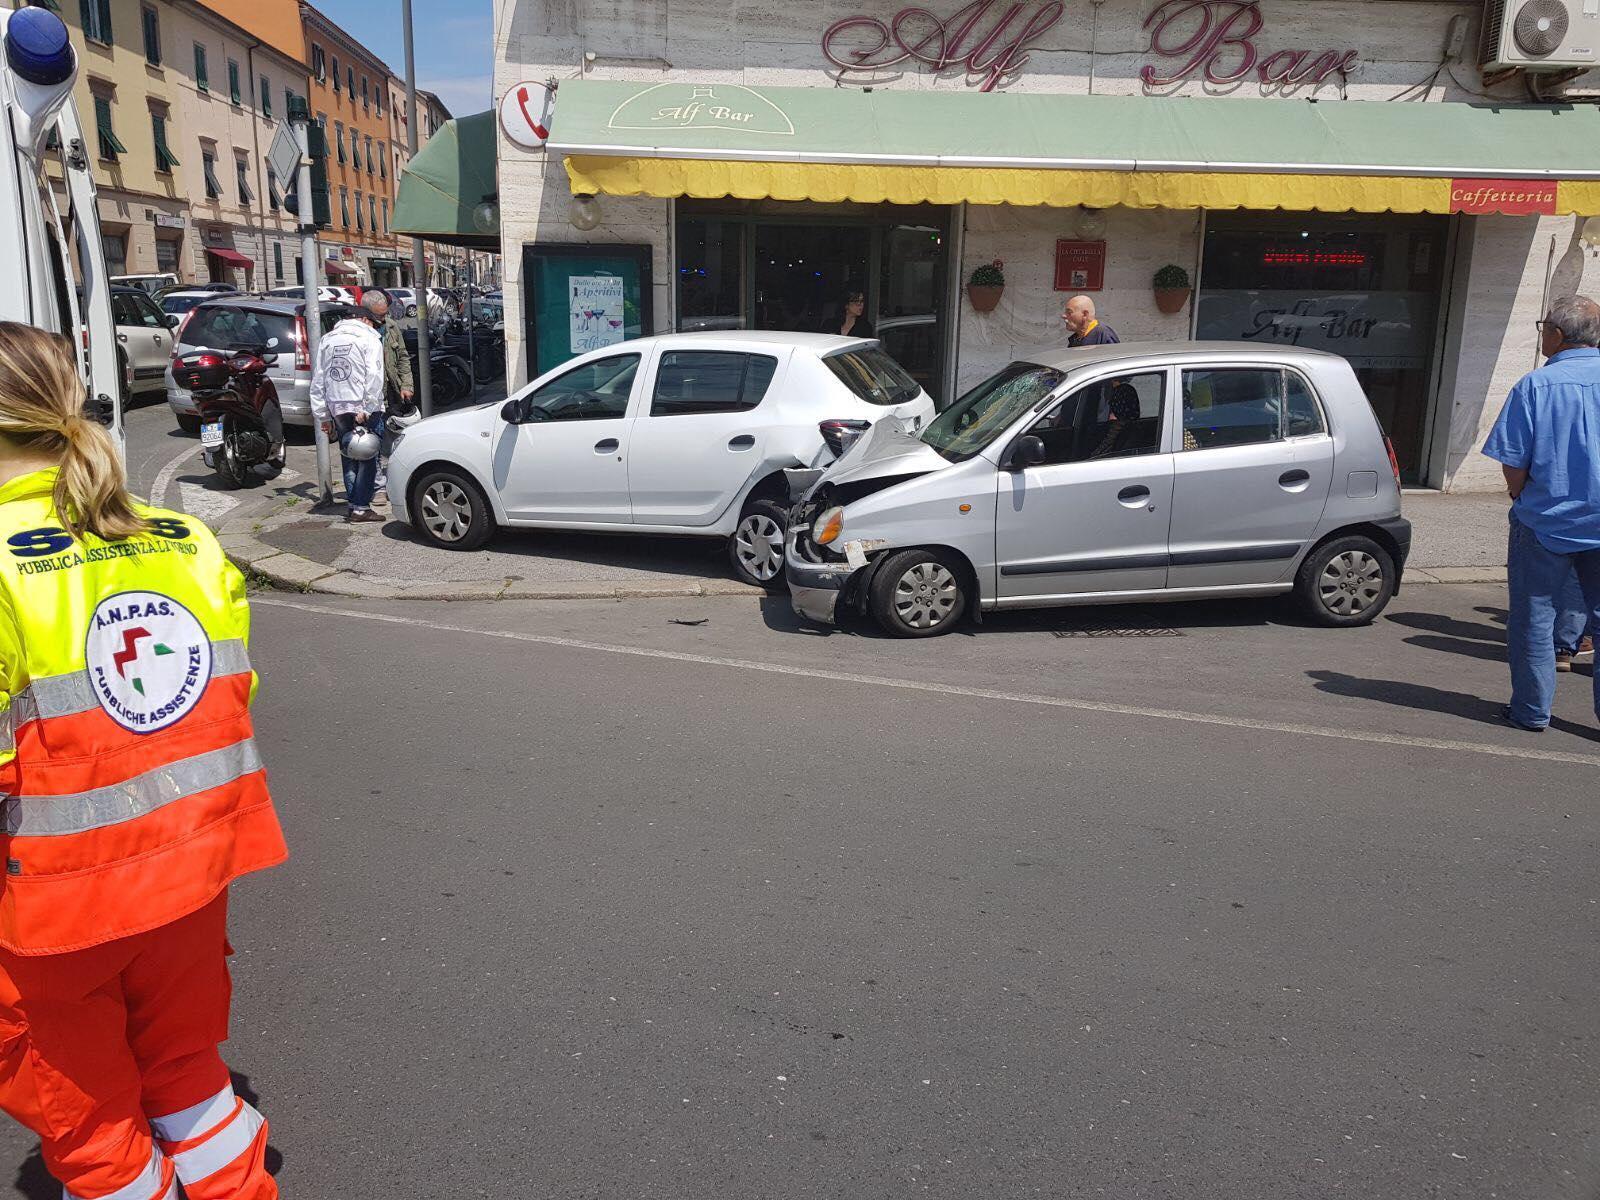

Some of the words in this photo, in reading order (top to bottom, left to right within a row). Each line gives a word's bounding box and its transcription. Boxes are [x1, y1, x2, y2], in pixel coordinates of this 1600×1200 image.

[822, 0, 1064, 93] Alf
[1142, 0, 1360, 86] Bar
[651, 102, 706, 126] Alf
[708, 106, 755, 122] Bar
[1451, 187, 1554, 207] Caffetteria
[578, 287, 622, 298] Aperitivi
[1319, 309, 1378, 339] Bar
[16, 552, 84, 576] PUBBLICA
[84, 541, 156, 563] ASSISTENZA
[95, 666, 147, 724] PUBBLICHE
[149, 644, 201, 724] ASSISTENZE
